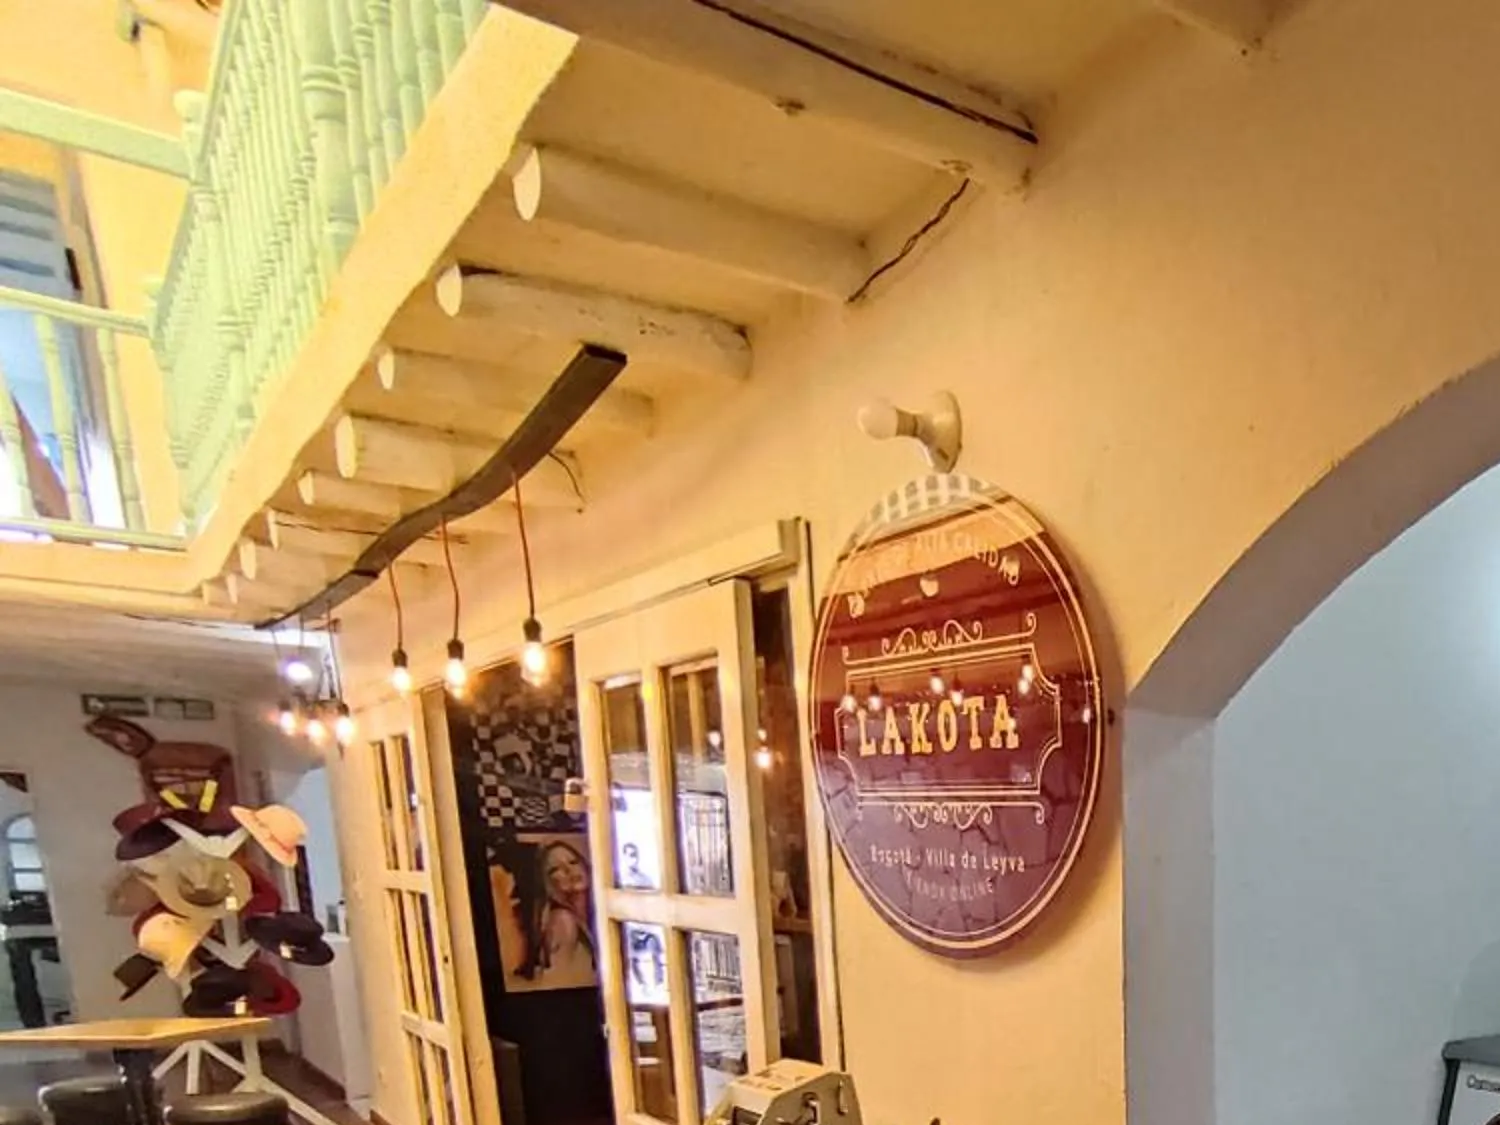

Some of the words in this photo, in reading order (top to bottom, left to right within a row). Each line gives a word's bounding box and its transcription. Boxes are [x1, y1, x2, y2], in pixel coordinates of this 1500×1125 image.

[857, 694, 1019, 756] LAKOTA
[926, 847, 956, 868] Villa
[961, 849, 977, 869] de
[983, 841, 1025, 876] Leyva
